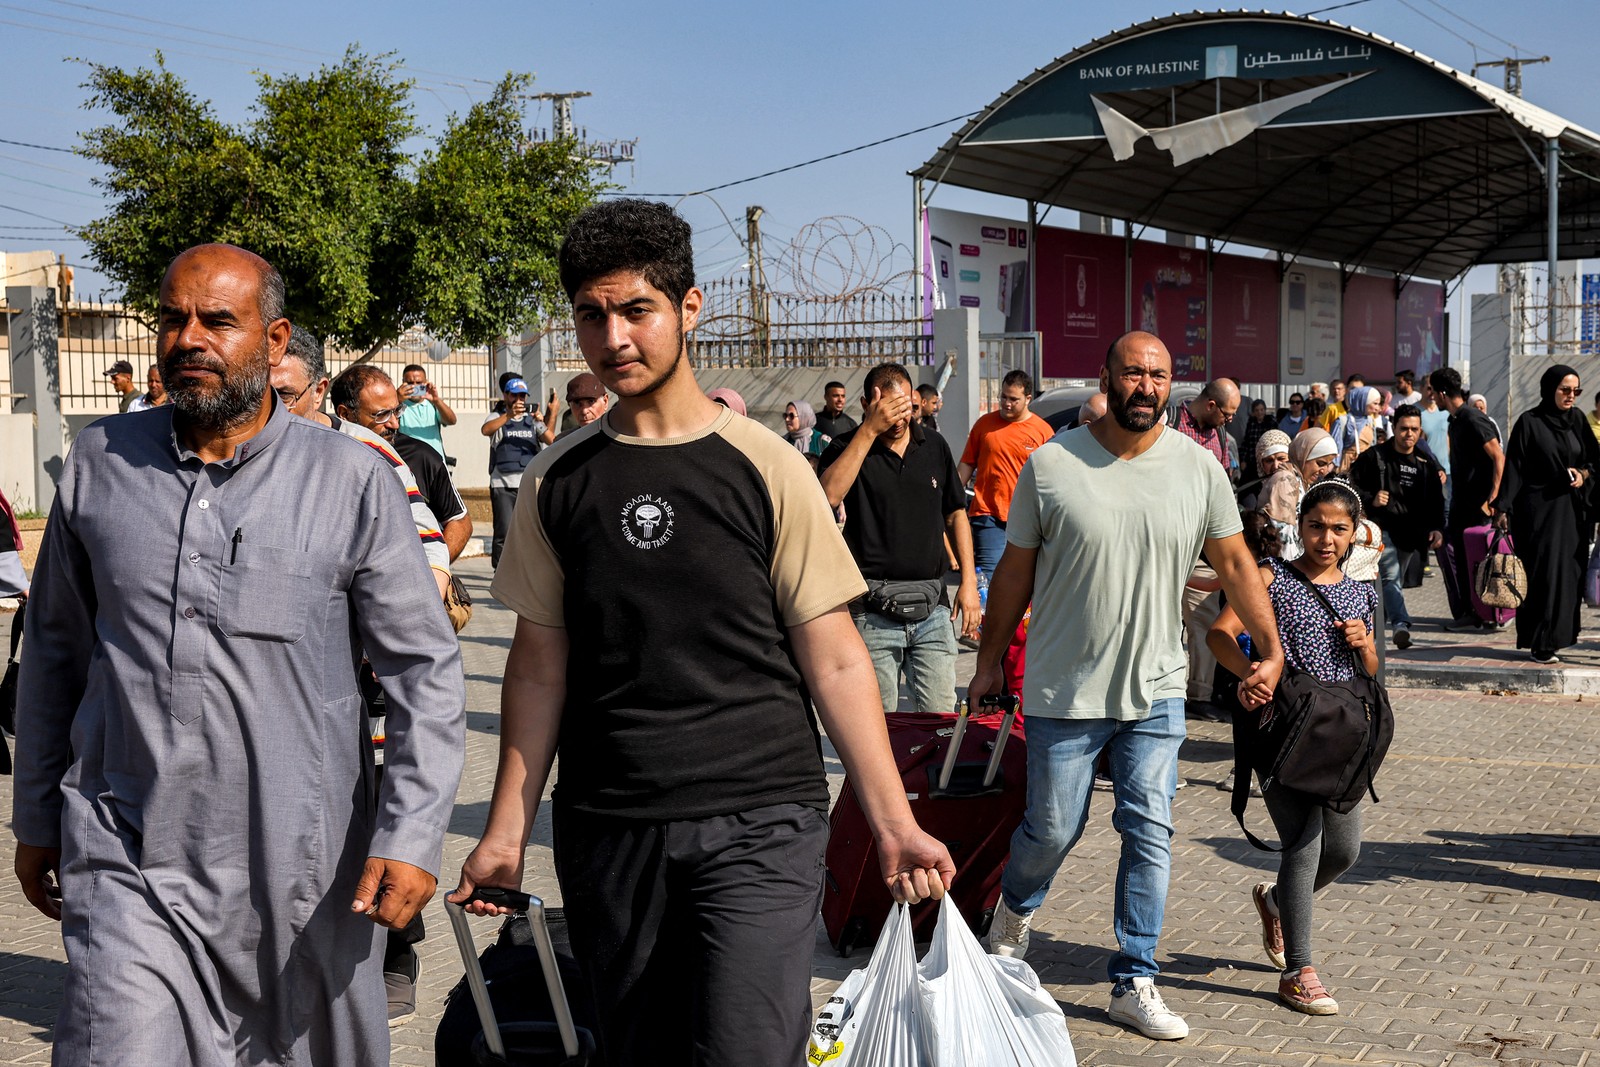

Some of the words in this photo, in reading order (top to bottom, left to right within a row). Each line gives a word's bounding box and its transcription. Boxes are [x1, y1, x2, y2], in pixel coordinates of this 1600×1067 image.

[1244, 48, 1323, 68] فلسطين
[1328, 44, 1371, 60] بنك
[1079, 67, 1113, 79] BANK
[1116, 65, 1133, 77] OF
[1136, 60, 1200, 75] PALESTINE
[1190, 355, 1206, 371] 700
[622, 526, 637, 546] COME
[636, 540, 651, 549] AND
